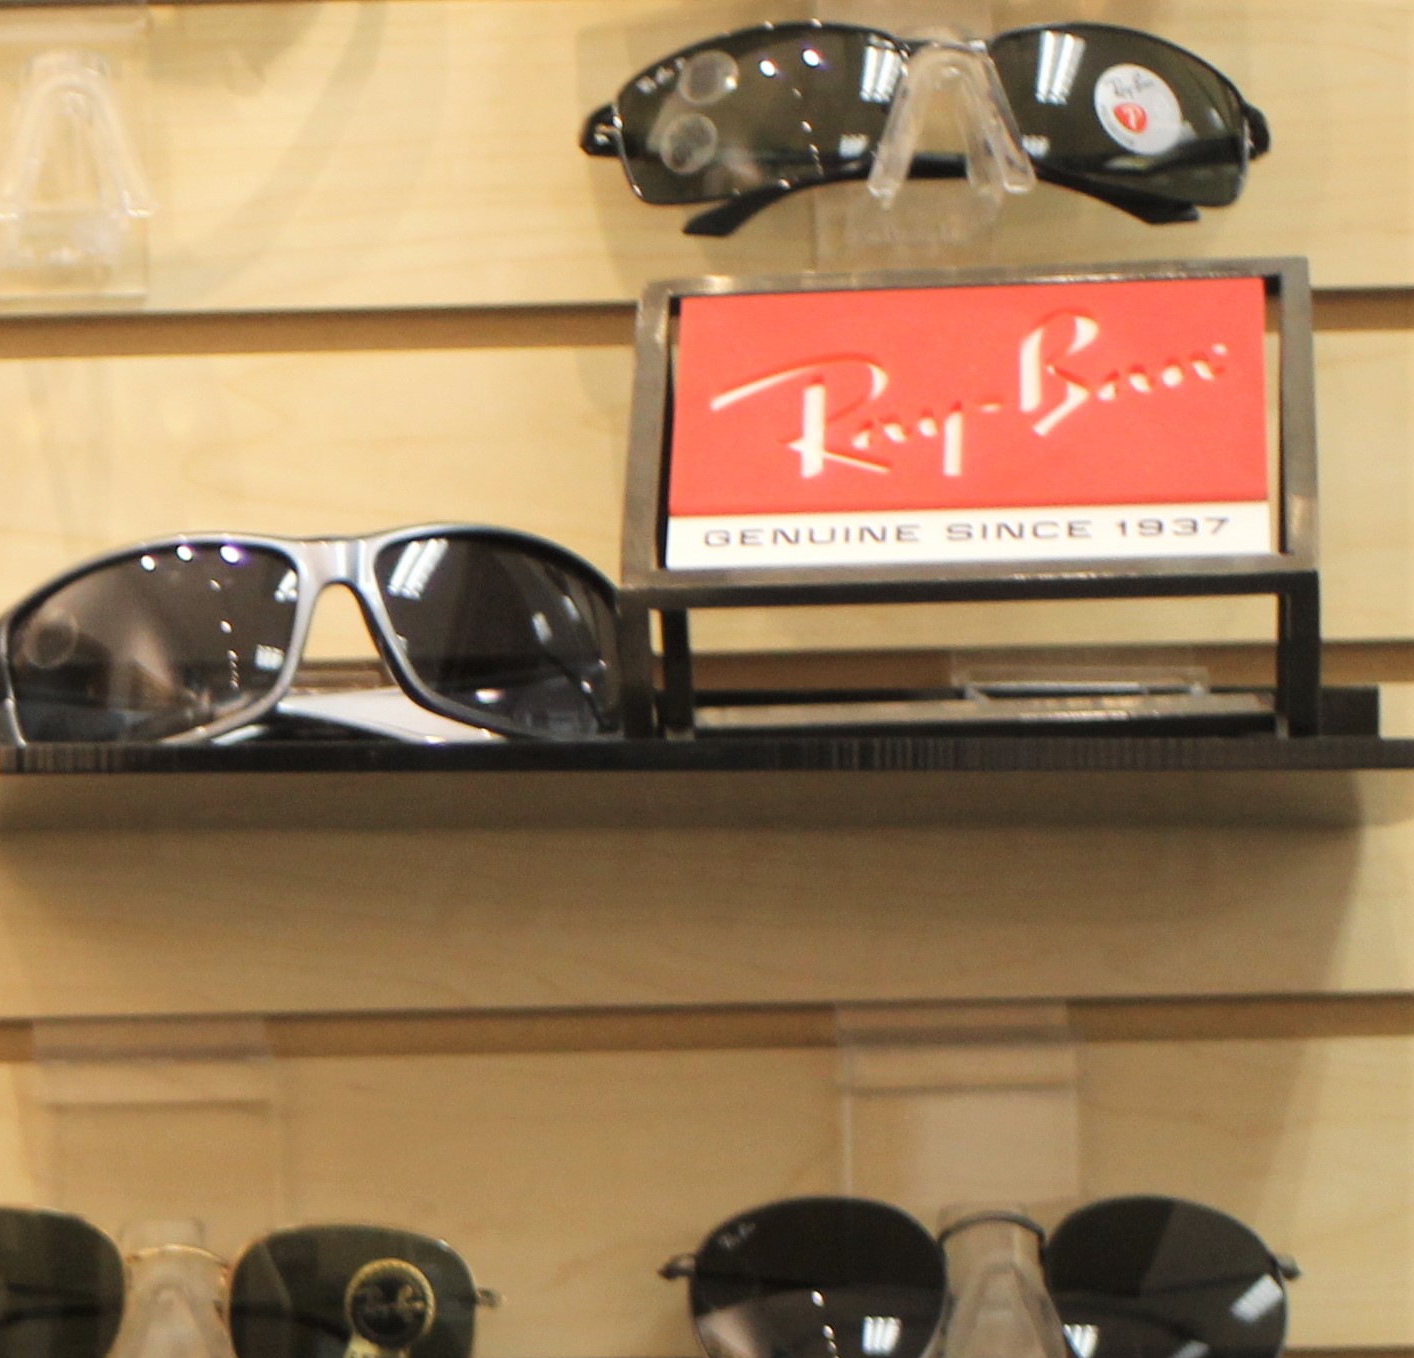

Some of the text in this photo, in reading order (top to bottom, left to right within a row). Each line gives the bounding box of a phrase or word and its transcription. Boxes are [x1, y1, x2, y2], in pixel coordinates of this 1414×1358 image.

[711, 306, 1227, 478] Ray-Ban
[704, 516, 1231, 548] GENUINE SINCE 1937
